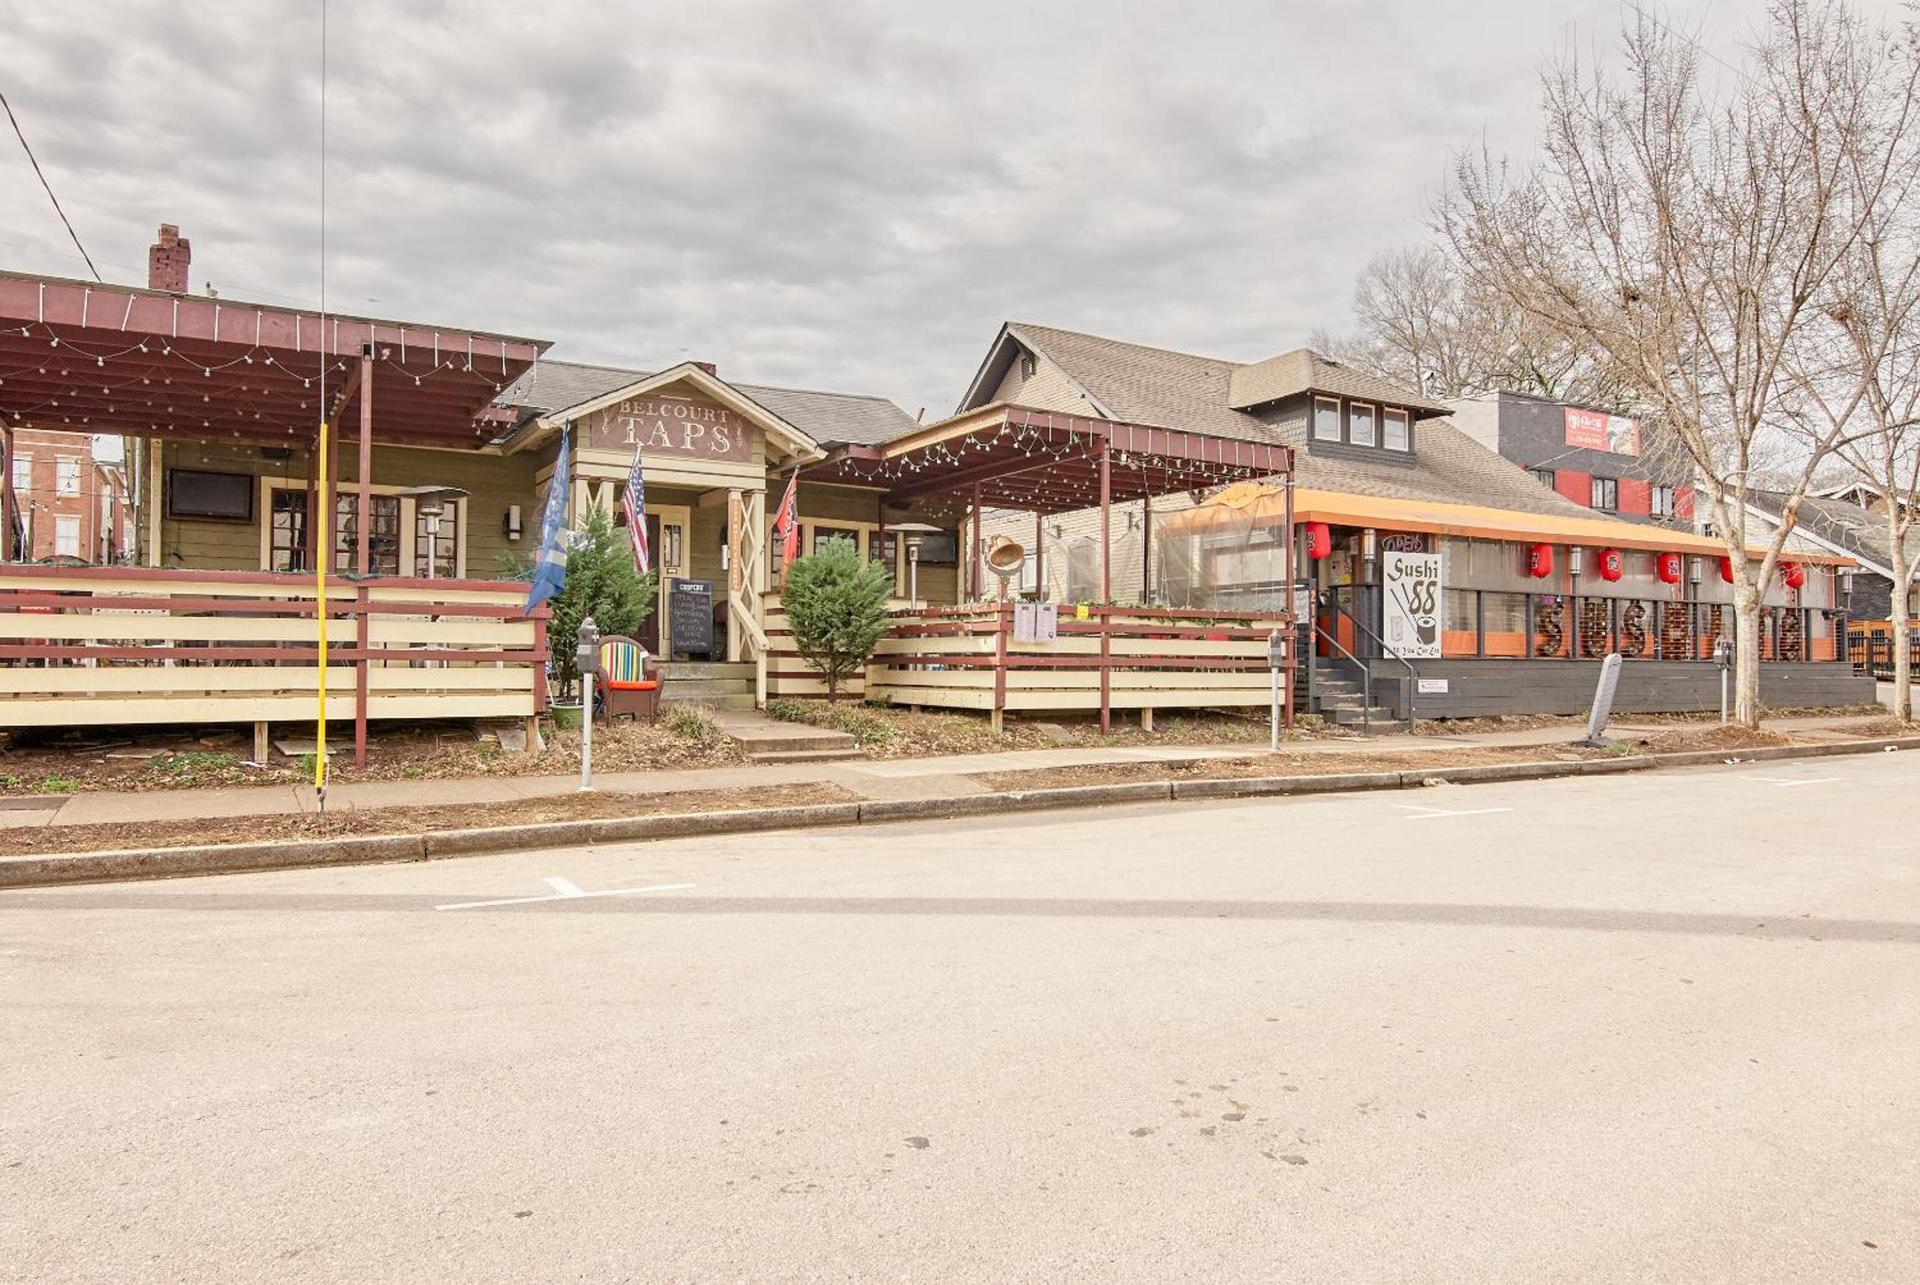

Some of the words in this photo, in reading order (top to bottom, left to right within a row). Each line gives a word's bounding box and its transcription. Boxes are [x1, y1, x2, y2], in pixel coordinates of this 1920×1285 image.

[619, 401, 730, 423] BELCOURT
[617, 416, 731, 453] TAPS
[1387, 558, 1438, 581] Sushi
[1409, 581, 1437, 614] 88
